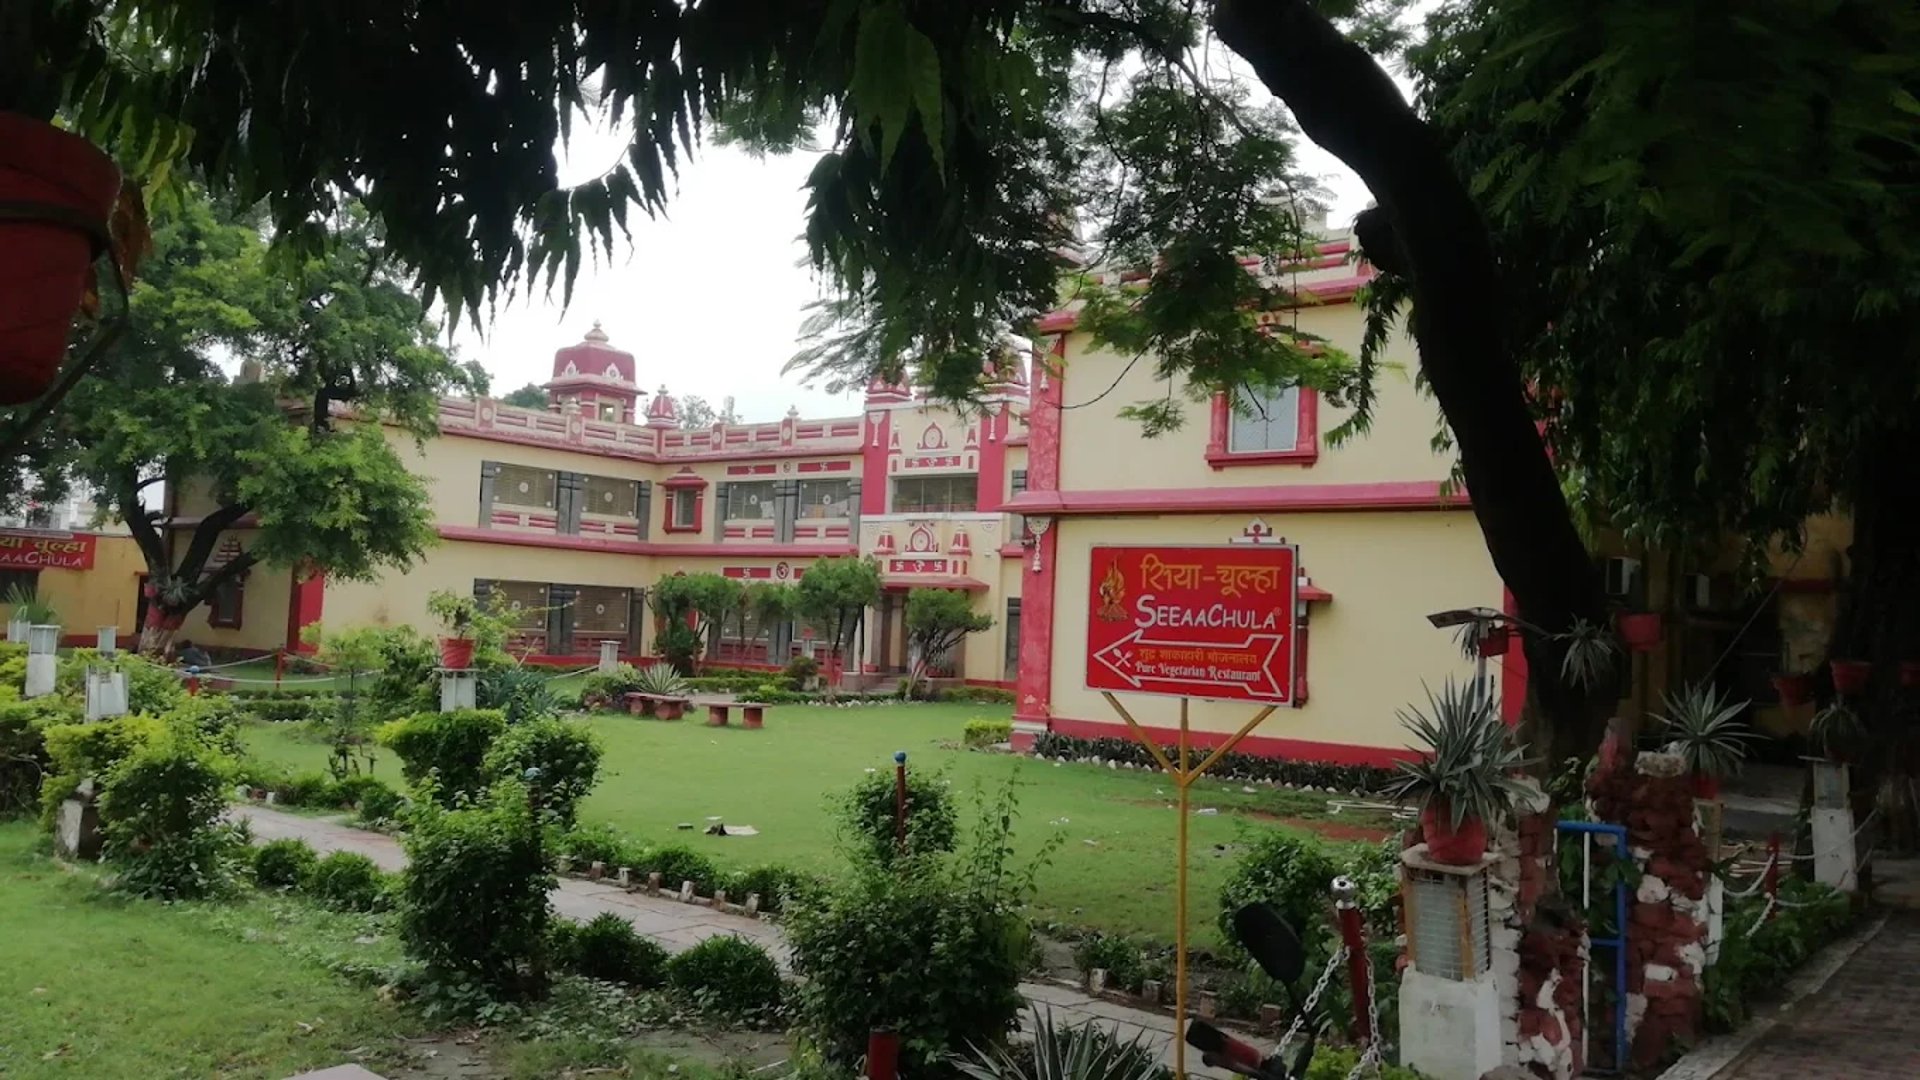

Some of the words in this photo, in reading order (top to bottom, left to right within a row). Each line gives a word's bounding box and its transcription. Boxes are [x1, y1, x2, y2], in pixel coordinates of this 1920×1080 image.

[1159, 648, 1204, 661] शाकाहारी
[1207, 651, 1257, 665] भोजनालय
[1134, 660, 1156, 674] Pure
[1157, 662, 1206, 679] Vegetarian
[1207, 665, 1261, 682] Restaurant
